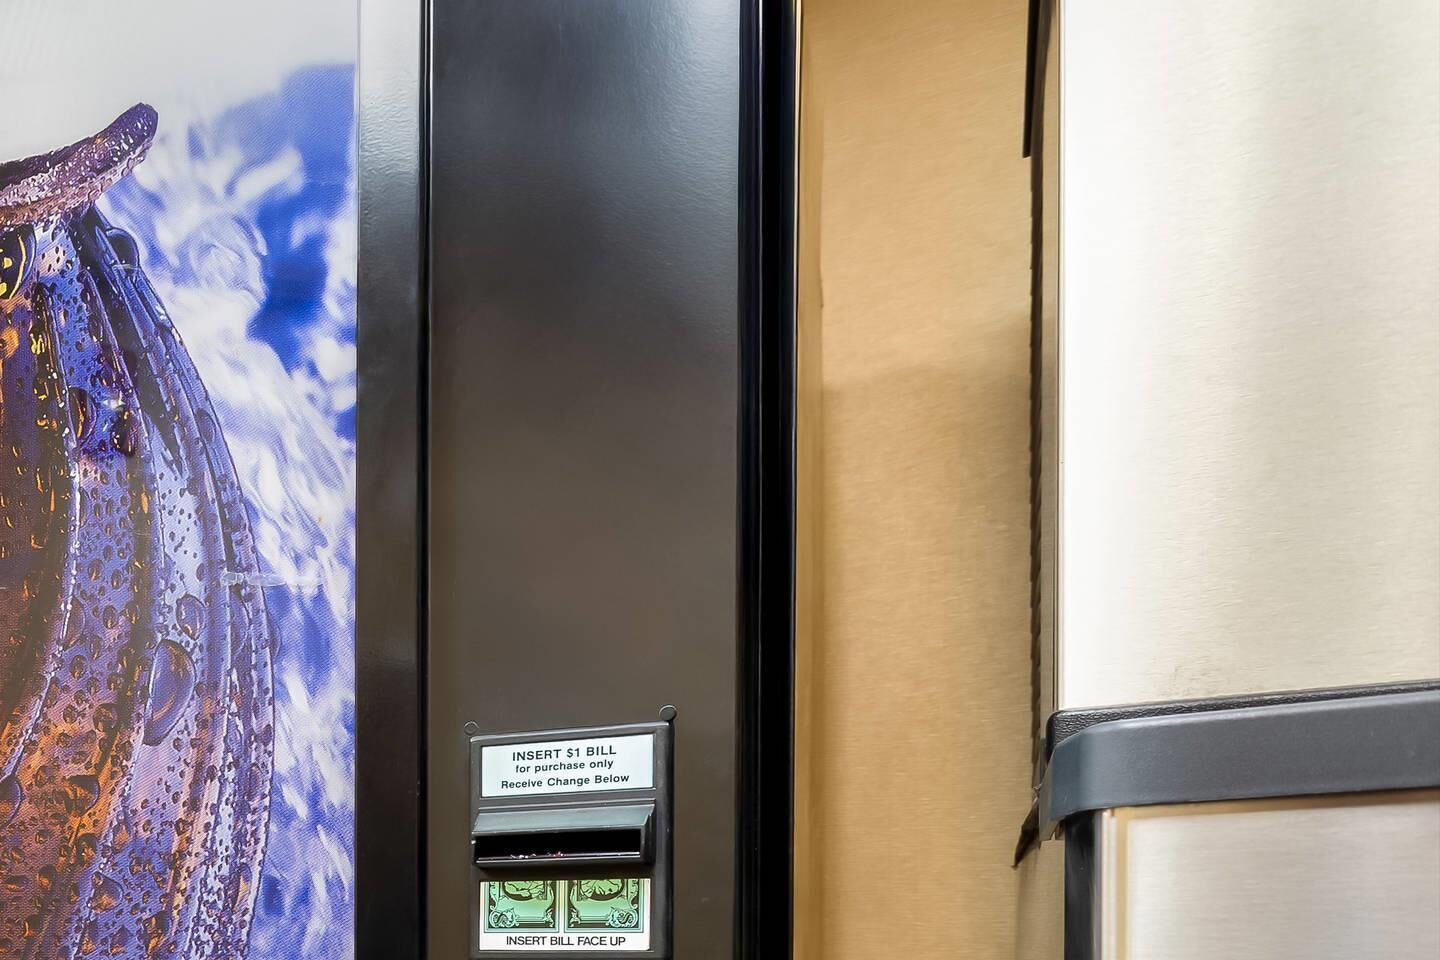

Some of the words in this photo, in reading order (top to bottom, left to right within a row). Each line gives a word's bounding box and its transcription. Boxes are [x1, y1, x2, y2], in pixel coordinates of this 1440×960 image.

[512, 748, 561, 762] INSERT
[566, 747, 581, 760] $1
[586, 744, 617, 757] BILL
[515, 764, 531, 774] for
[534, 761, 585, 774] purchase
[589, 759, 614, 771] only
[501, 778, 543, 789] Receive
[547, 776, 590, 788] Change
[594, 773, 630, 784] Below
[506, 936, 548, 946] INSERT
[550, 936, 574, 946] BILL
[577, 936, 608, 946] FACE
[610, 936, 626, 946] UP
